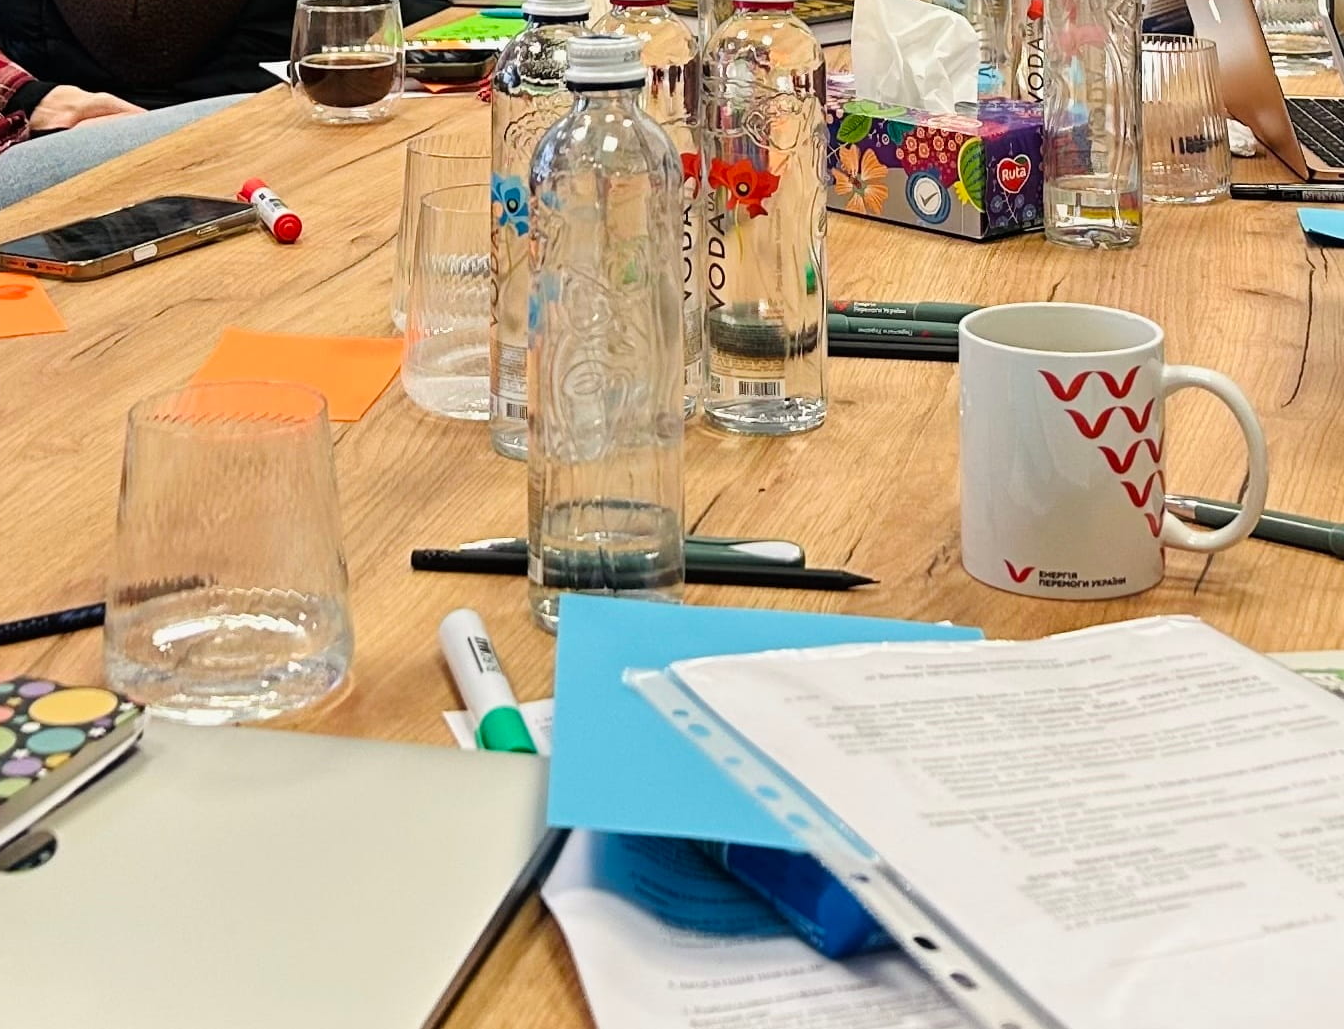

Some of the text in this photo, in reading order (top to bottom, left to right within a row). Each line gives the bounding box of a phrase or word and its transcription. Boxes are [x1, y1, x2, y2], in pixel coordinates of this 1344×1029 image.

[1001, 165, 1027, 181] Ruta
[707, 190, 726, 313] VODA UA
[1038, 570, 1078, 579] ЕНЕРГІЯ
[1038, 576, 1127, 588] ПЕРЕМОГИ УКРАЇНИ
